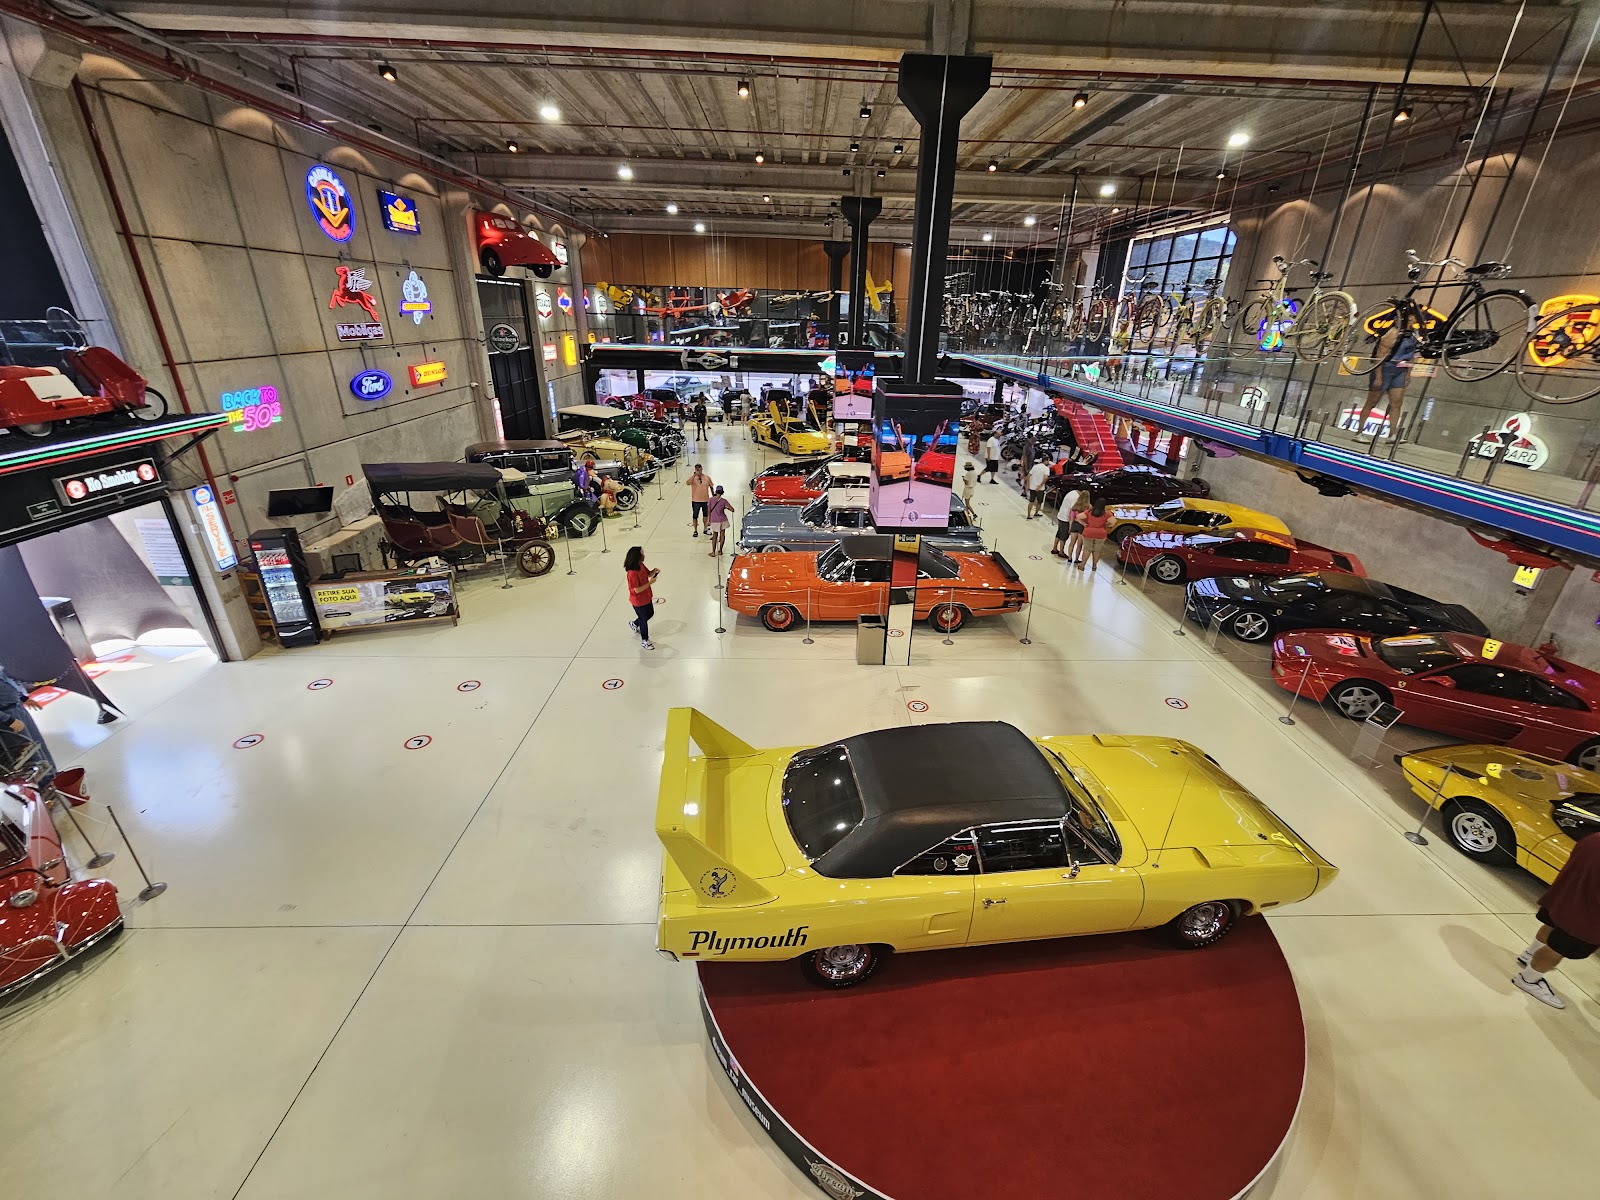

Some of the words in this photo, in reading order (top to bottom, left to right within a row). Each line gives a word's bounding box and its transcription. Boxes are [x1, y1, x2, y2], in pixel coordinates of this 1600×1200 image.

[336, 324, 383, 339] Mobilgas
[361, 375, 385, 395] Ford
[222, 389, 261, 411] BACK
[259, 386, 278, 404] TO
[227, 409, 245, 424] THE
[84, 477, 103, 493] No
[99, 469, 141, 488] Smoking
[317, 589, 341, 597] RETIRE
[339, 594, 357, 602] AQUI
[688, 925, 810, 956] Plymouth
